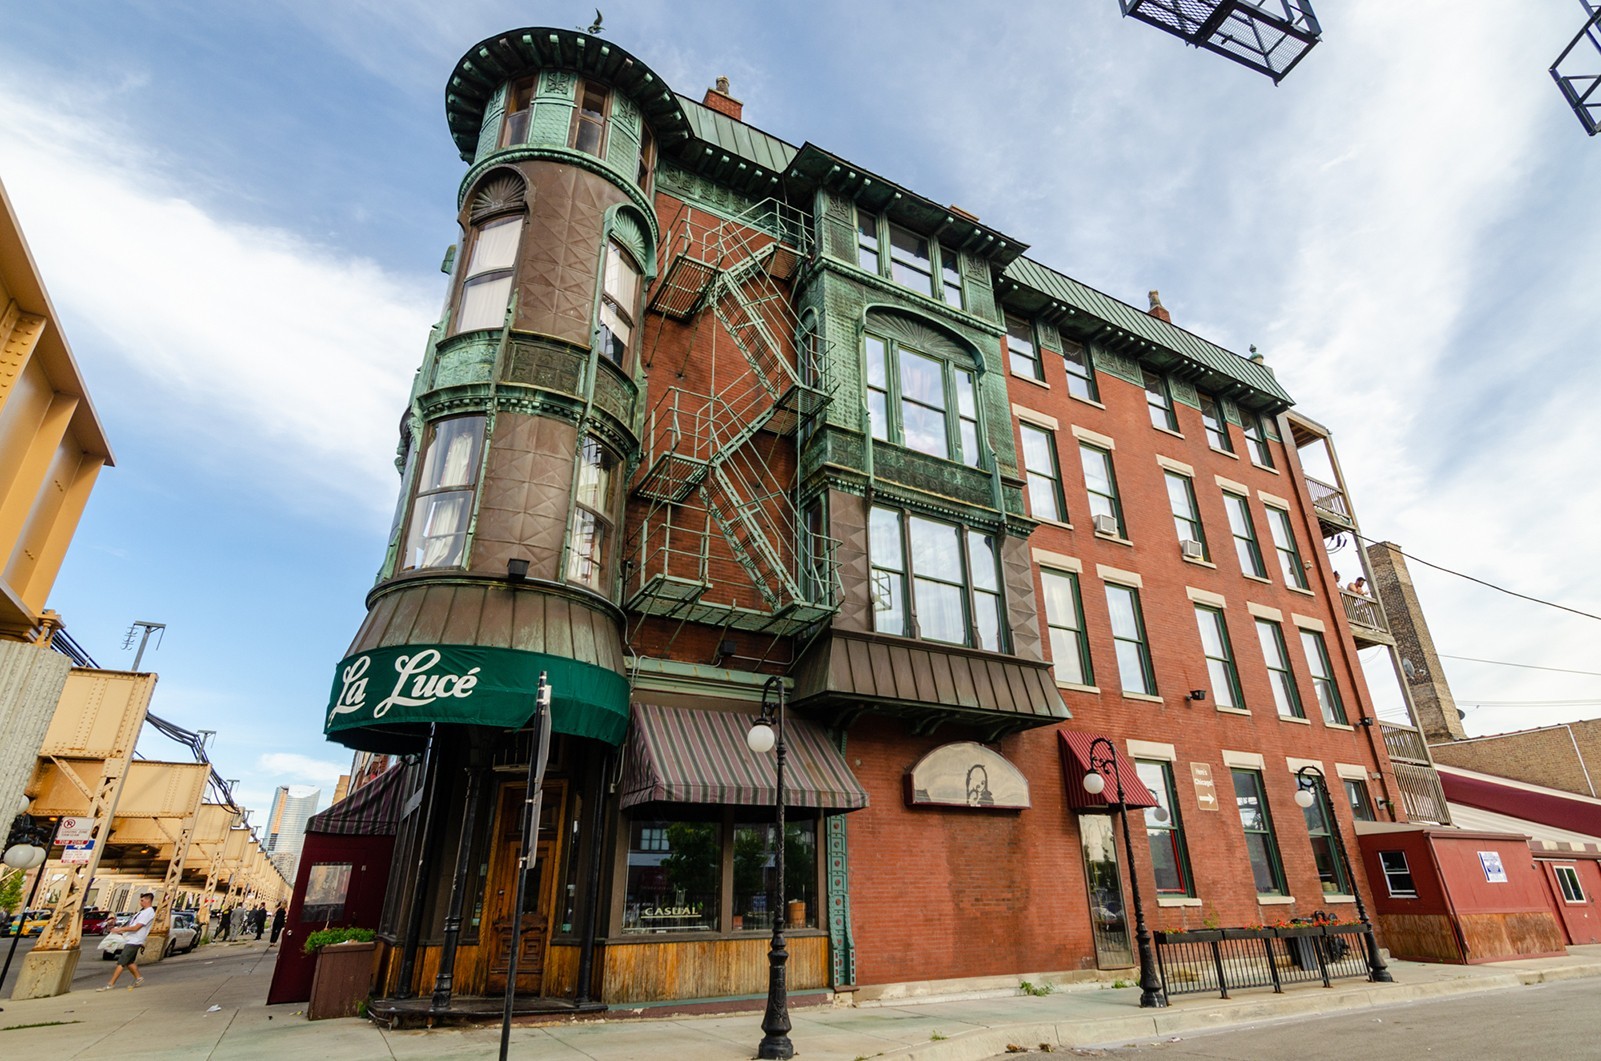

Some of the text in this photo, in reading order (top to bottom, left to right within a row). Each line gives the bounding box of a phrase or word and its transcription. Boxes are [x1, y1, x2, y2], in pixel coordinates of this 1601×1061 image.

[327, 649, 481, 728] La Lucé
[644, 906, 698, 916] CASUAL
